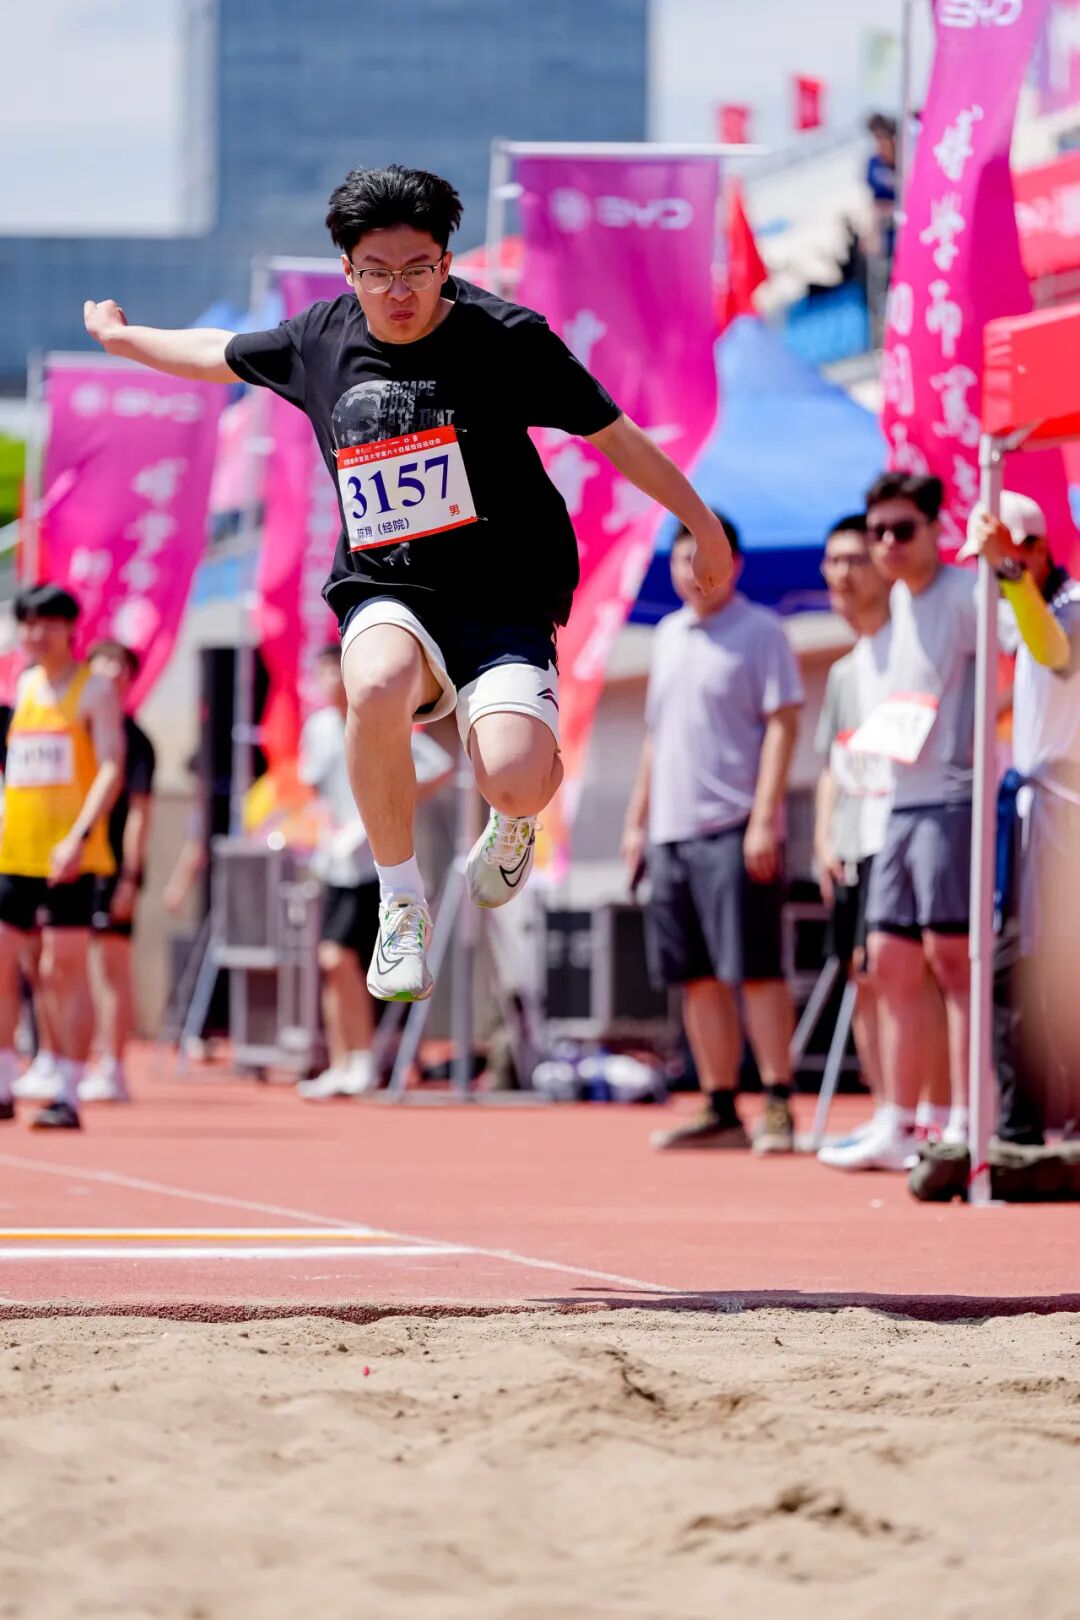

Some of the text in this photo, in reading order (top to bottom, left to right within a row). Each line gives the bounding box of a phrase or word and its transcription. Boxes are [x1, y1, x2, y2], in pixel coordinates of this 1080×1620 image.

[382, 380, 436, 397] ESCAPE
[347, 454, 449, 520] 3157
[449, 504, 460, 516] 男
